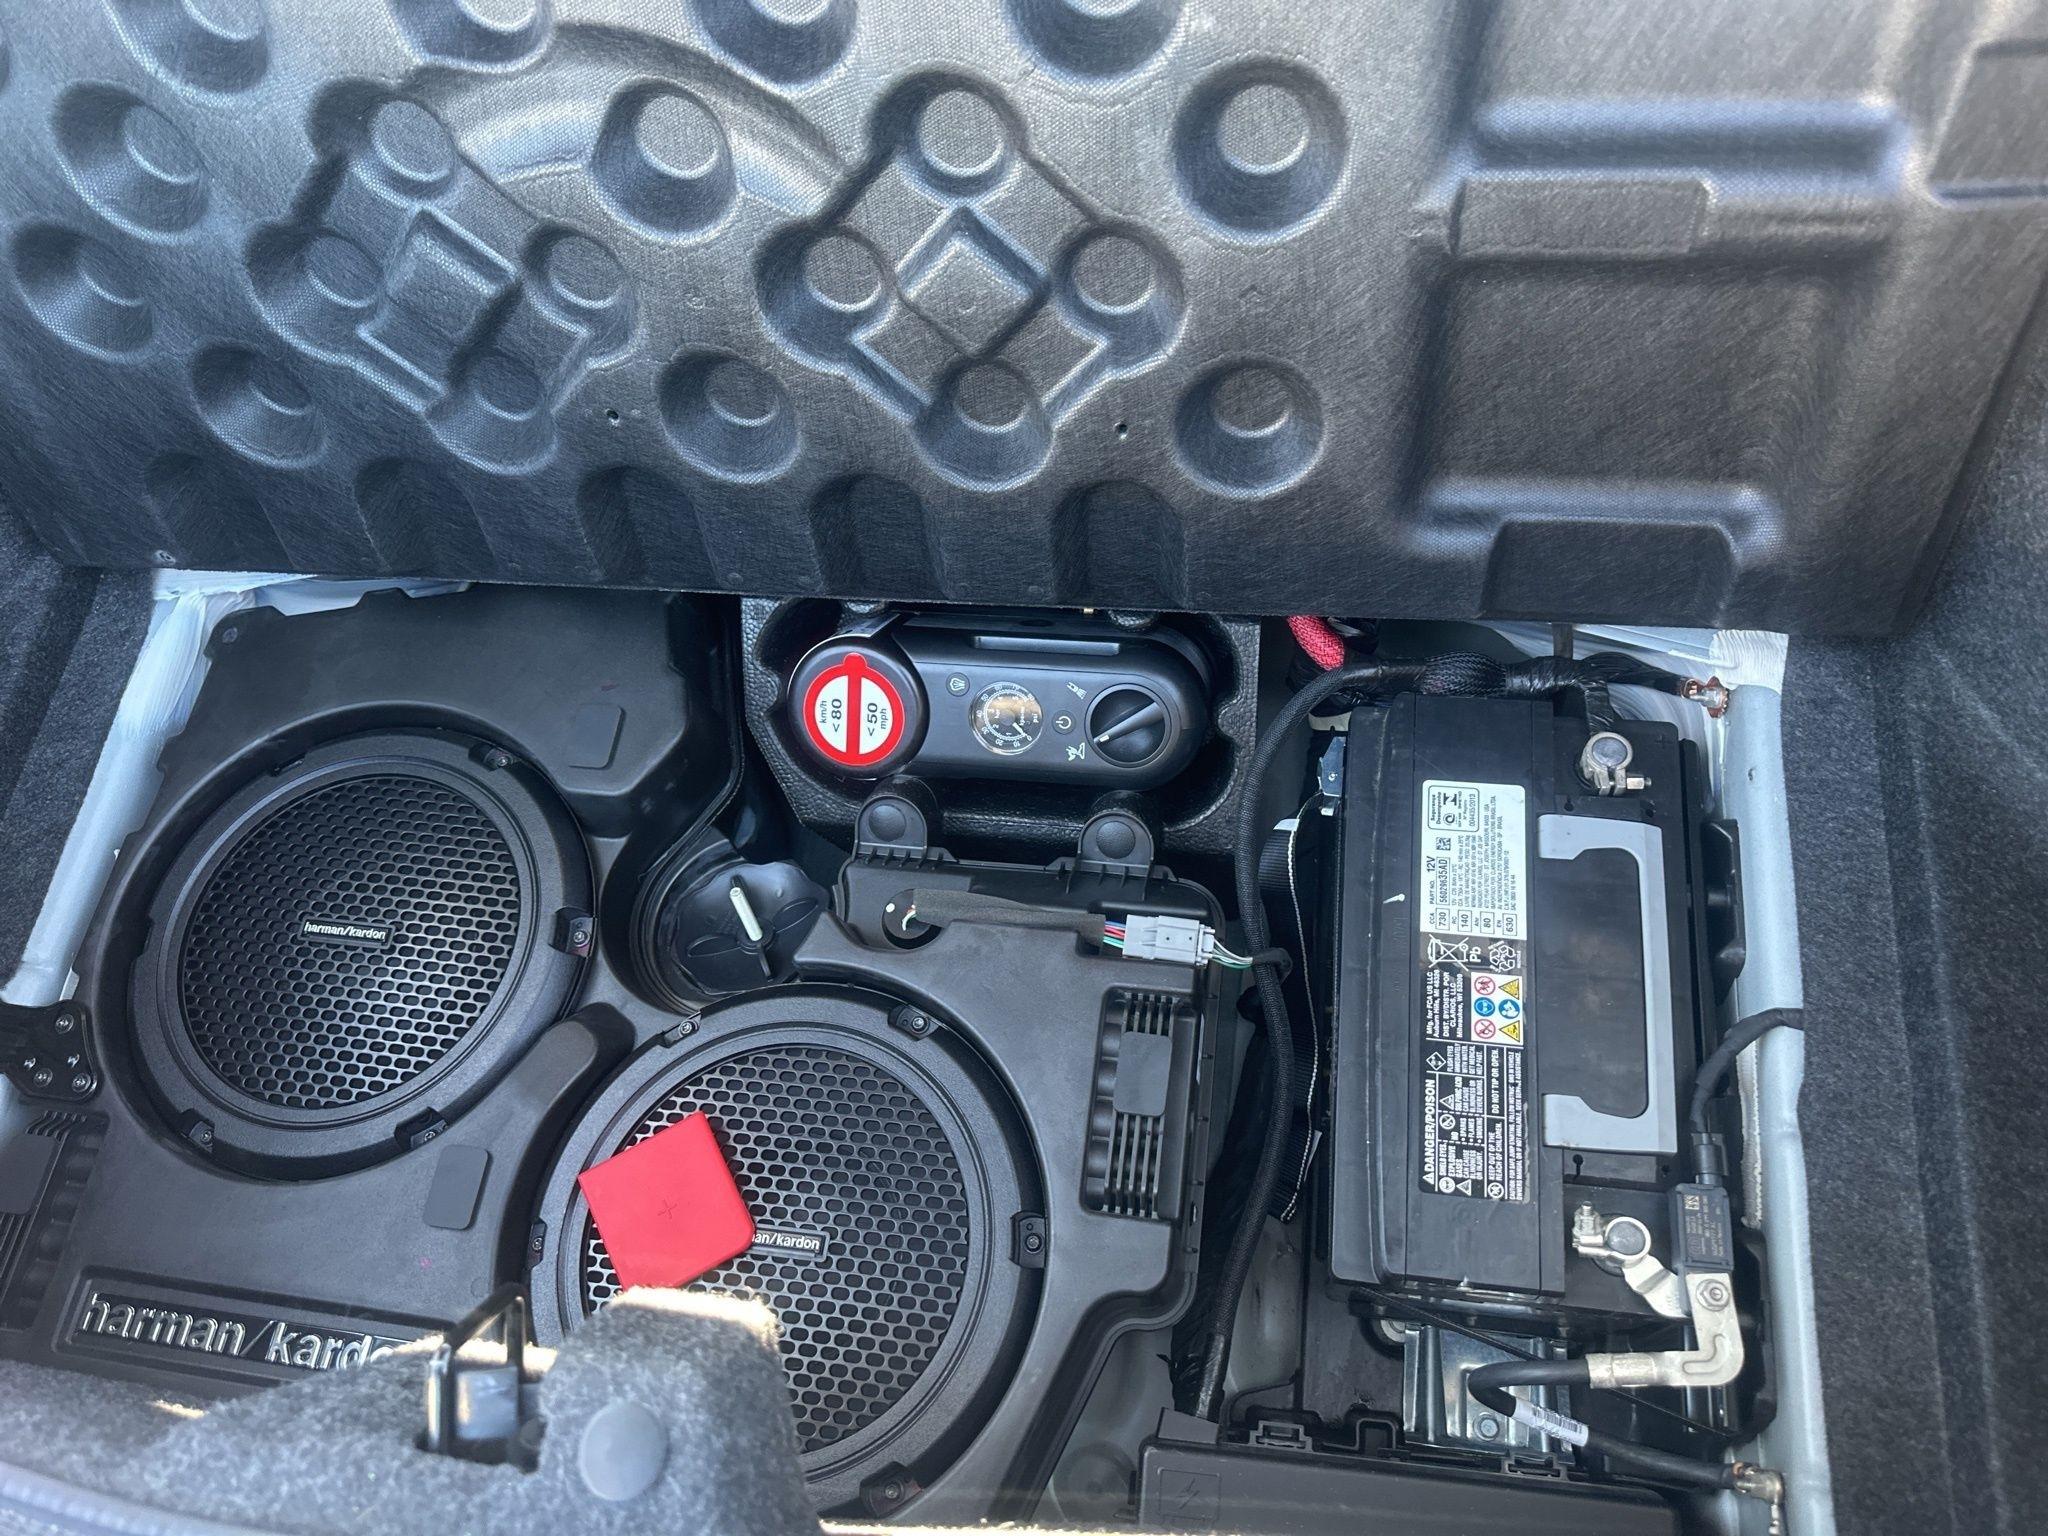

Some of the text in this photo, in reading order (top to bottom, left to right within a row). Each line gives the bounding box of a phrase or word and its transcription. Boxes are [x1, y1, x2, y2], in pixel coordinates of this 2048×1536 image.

[880, 708, 888, 729] mph
[1426, 856, 1435, 872] 12V
[304, 922, 386, 940] harman/kardon
[1470, 946, 1481, 962] Pb
[1426, 985, 1433, 994] US
[1457, 993, 1463, 1001] WI
[1426, 1020, 1434, 1034] Mfg.
[1491, 1048, 1499, 1114] DO NOT TIP OR OPEN.
[1424, 1079, 1435, 1172] DANGER/POISON
[1451, 1131, 1459, 1140] NO
[1489, 1144, 1495, 1152] OF
[752, 1232, 820, 1250] an/kardon
